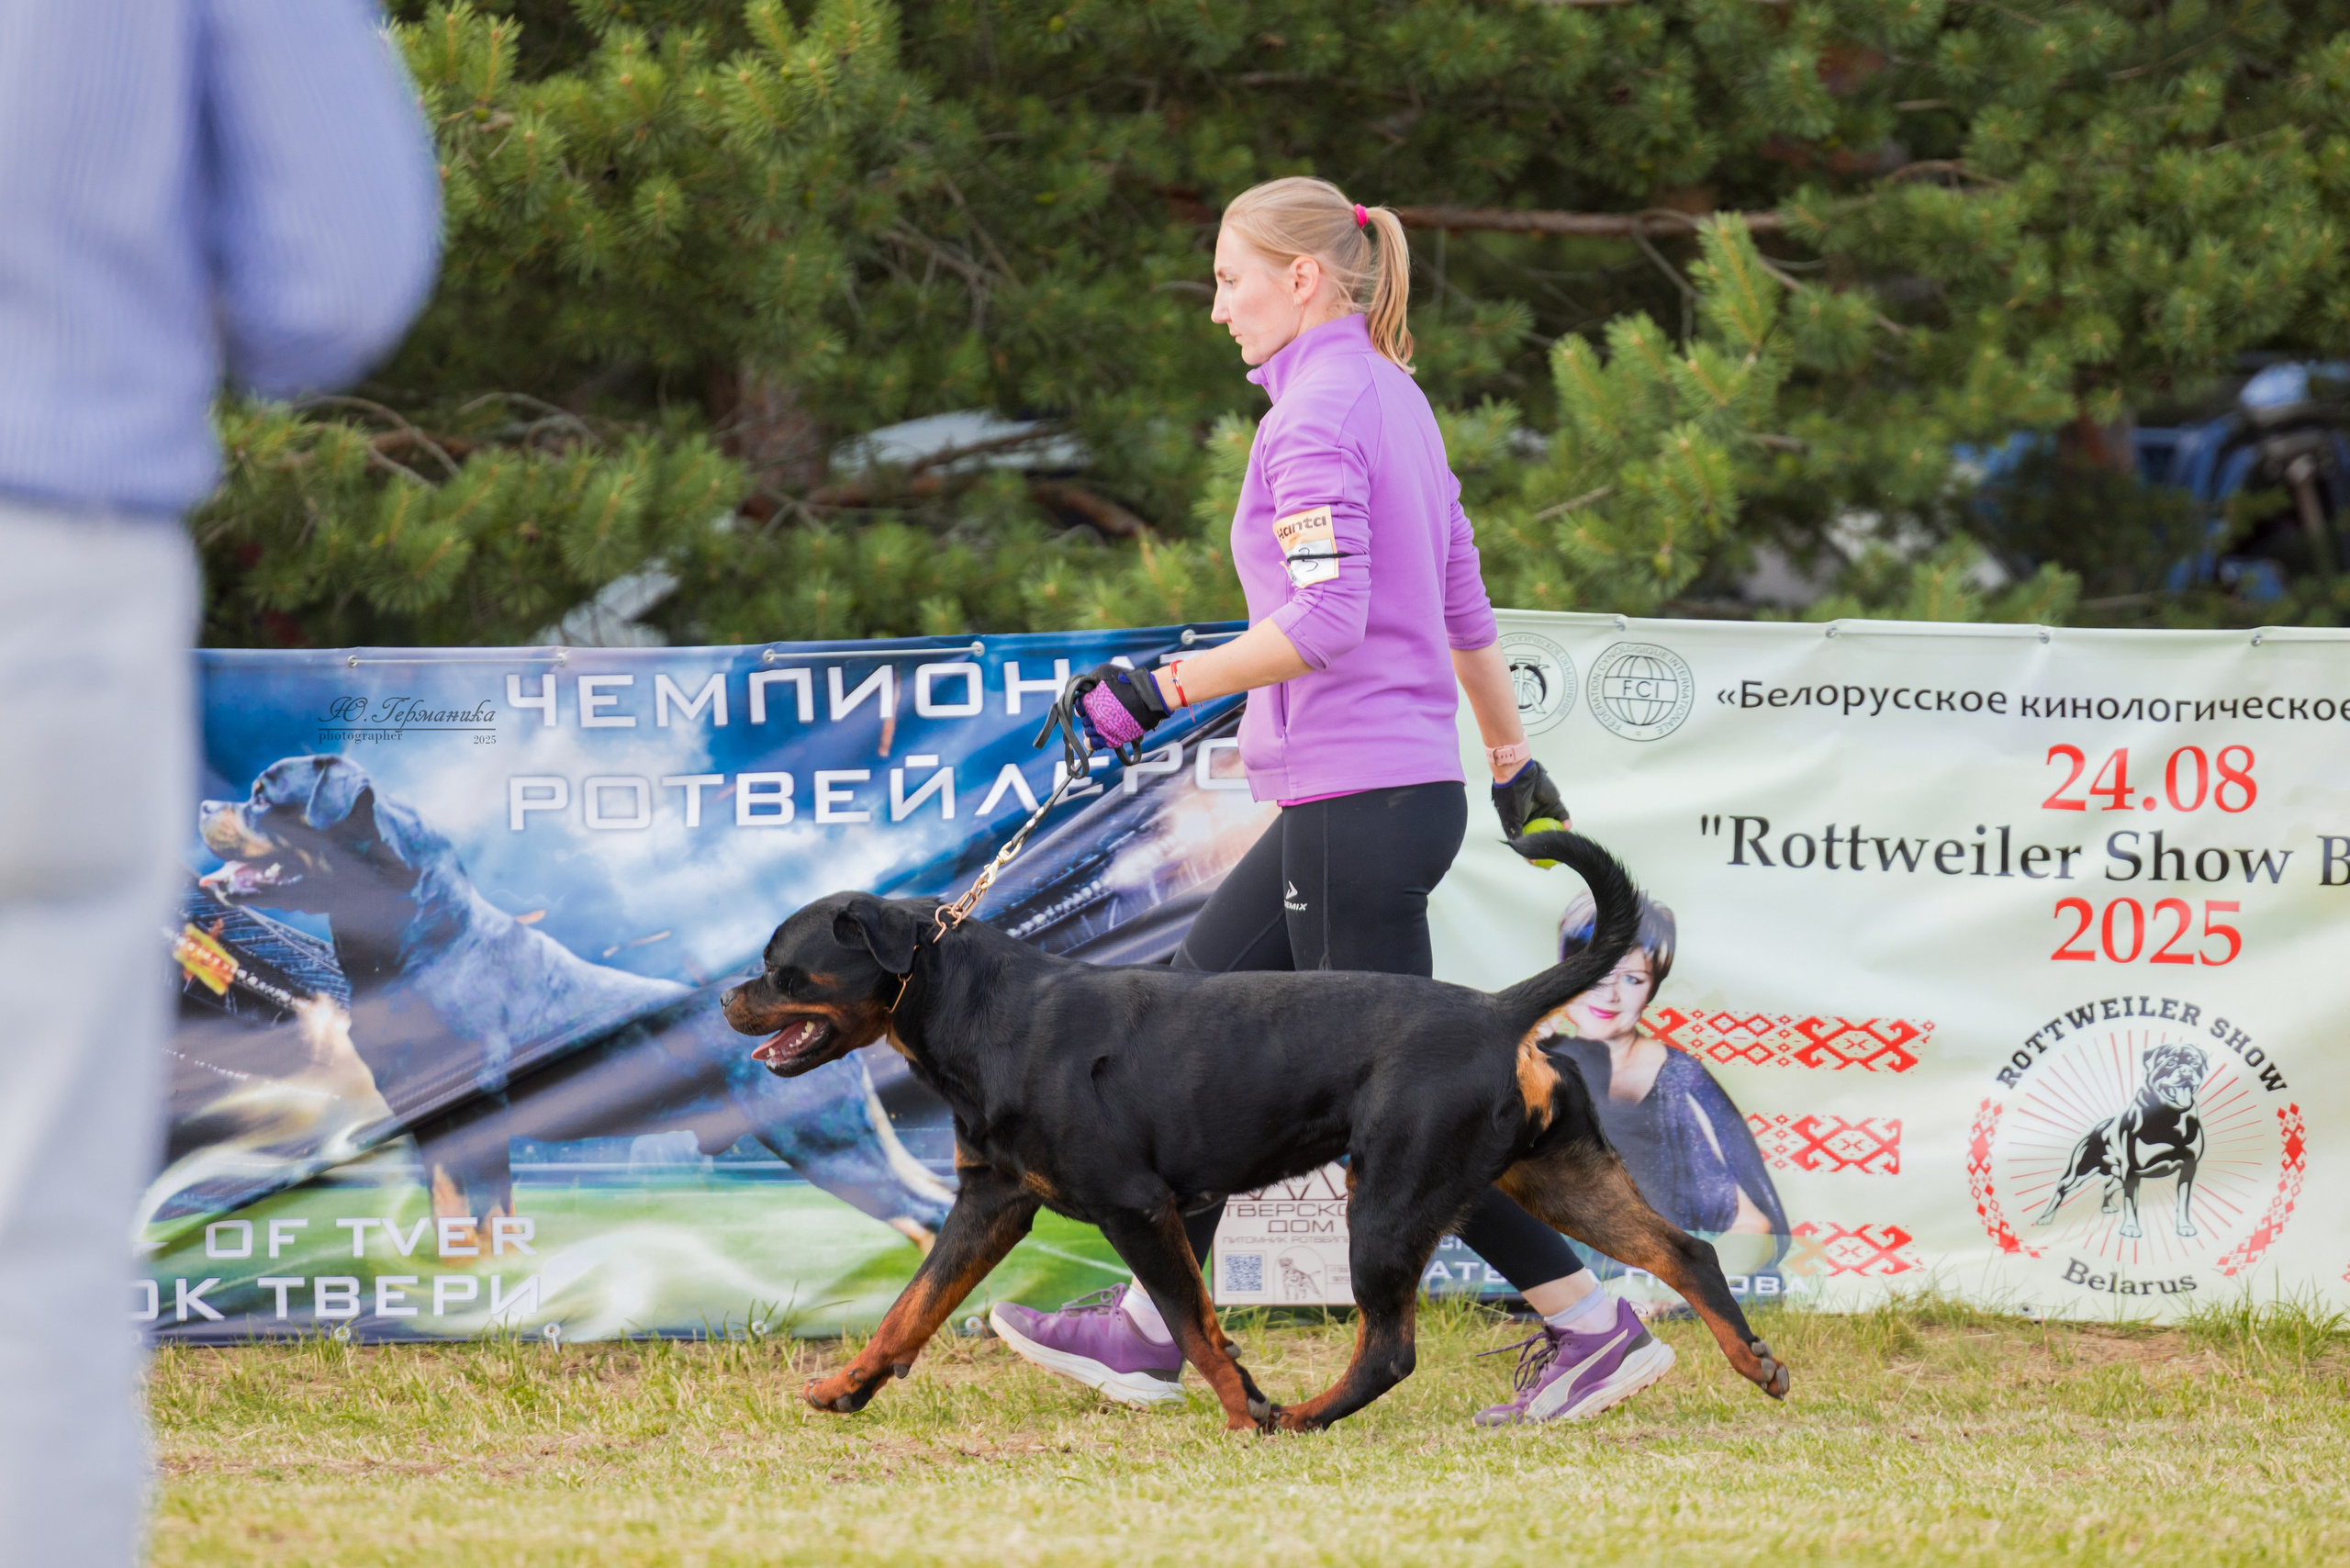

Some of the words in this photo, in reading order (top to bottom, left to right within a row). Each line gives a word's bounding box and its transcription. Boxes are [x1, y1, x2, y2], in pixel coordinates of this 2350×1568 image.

[506, 650, 1208, 728] ЧЕМПИОН
[1622, 679, 1660, 699] FCI
[1718, 680, 2008, 716] «Белорусское
[2041, 743, 2258, 813] 24.08
[1700, 814, 2082, 880] "Rottweiler
[2104, 829, 2294, 886] Show
[1283, 900, 1308, 912] EMIX
[2050, 896, 2243, 967] 2025
[1996, 995, 2202, 1091] ROTTWEILER
[2209, 1016, 2288, 1093] SHOW
[205, 1217, 309, 1260] OF
[335, 1215, 538, 1259] TVER
[1268, 1219, 1334, 1233] ДОМ
[257, 1274, 541, 1320] ТВЕРИ
[2060, 1257, 2198, 1296] Belarus
